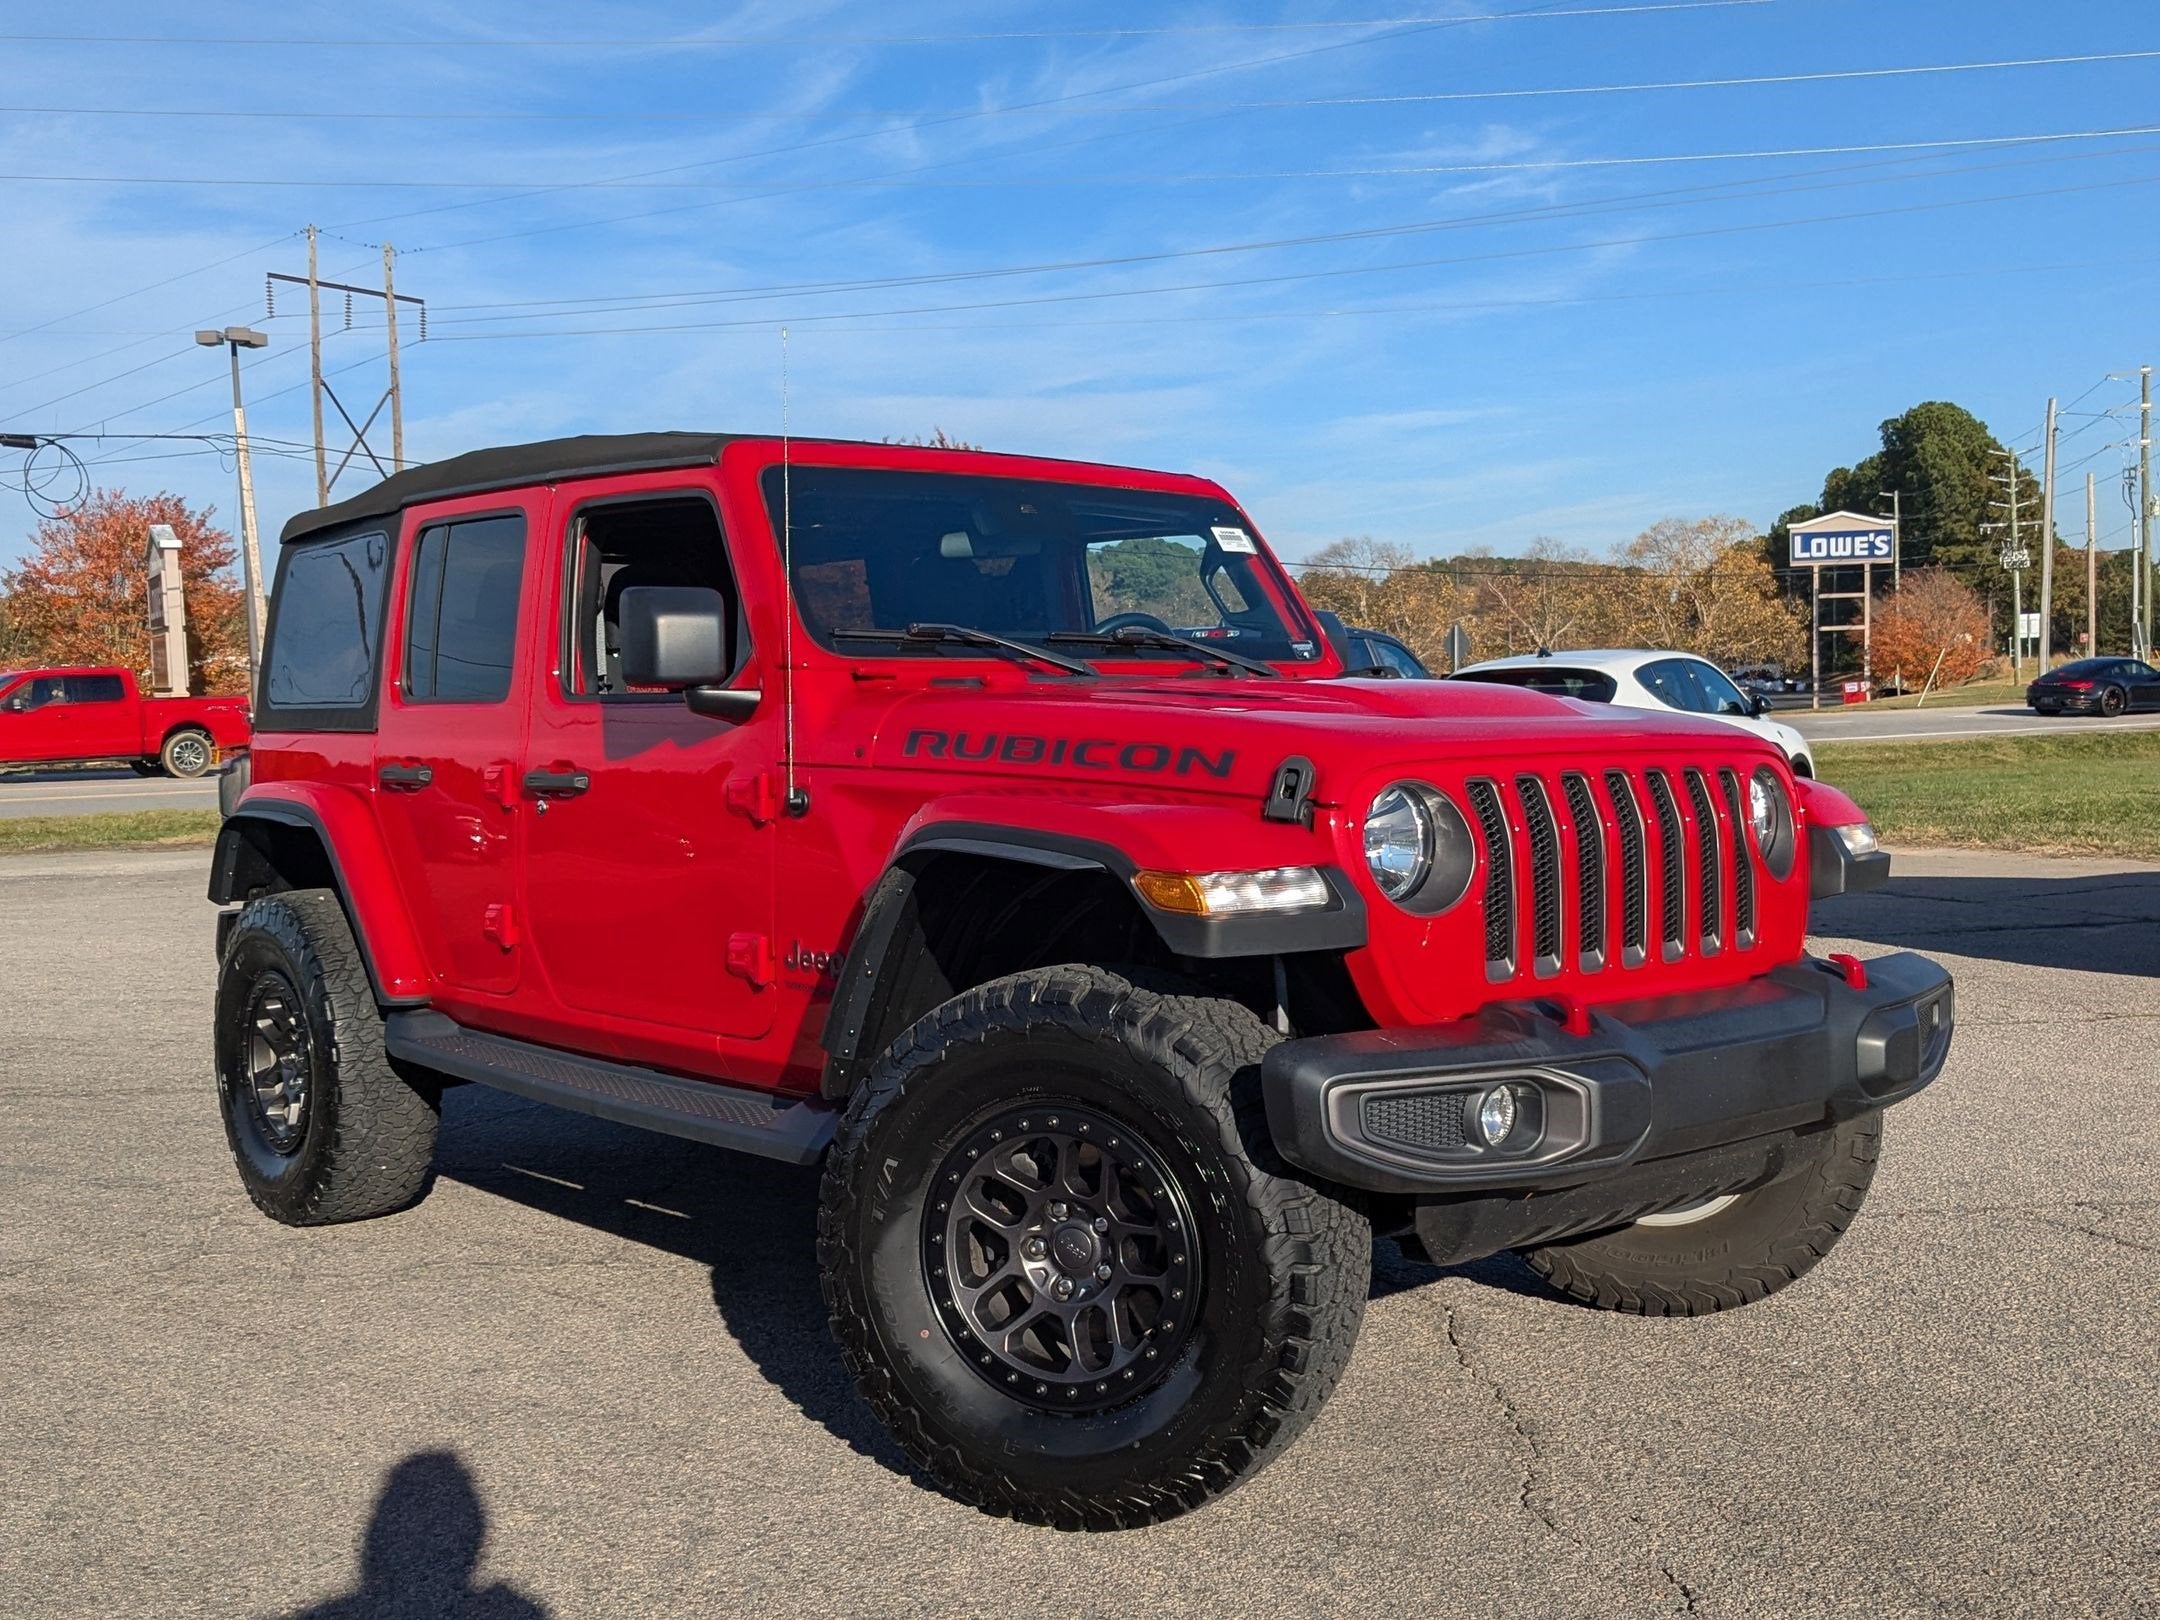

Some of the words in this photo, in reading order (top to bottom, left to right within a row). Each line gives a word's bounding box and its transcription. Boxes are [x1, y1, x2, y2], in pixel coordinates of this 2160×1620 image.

[1794, 532, 1890, 559] LOWE'S
[903, 729, 1236, 778] RUBICON
[784, 939, 846, 979] Jeep
